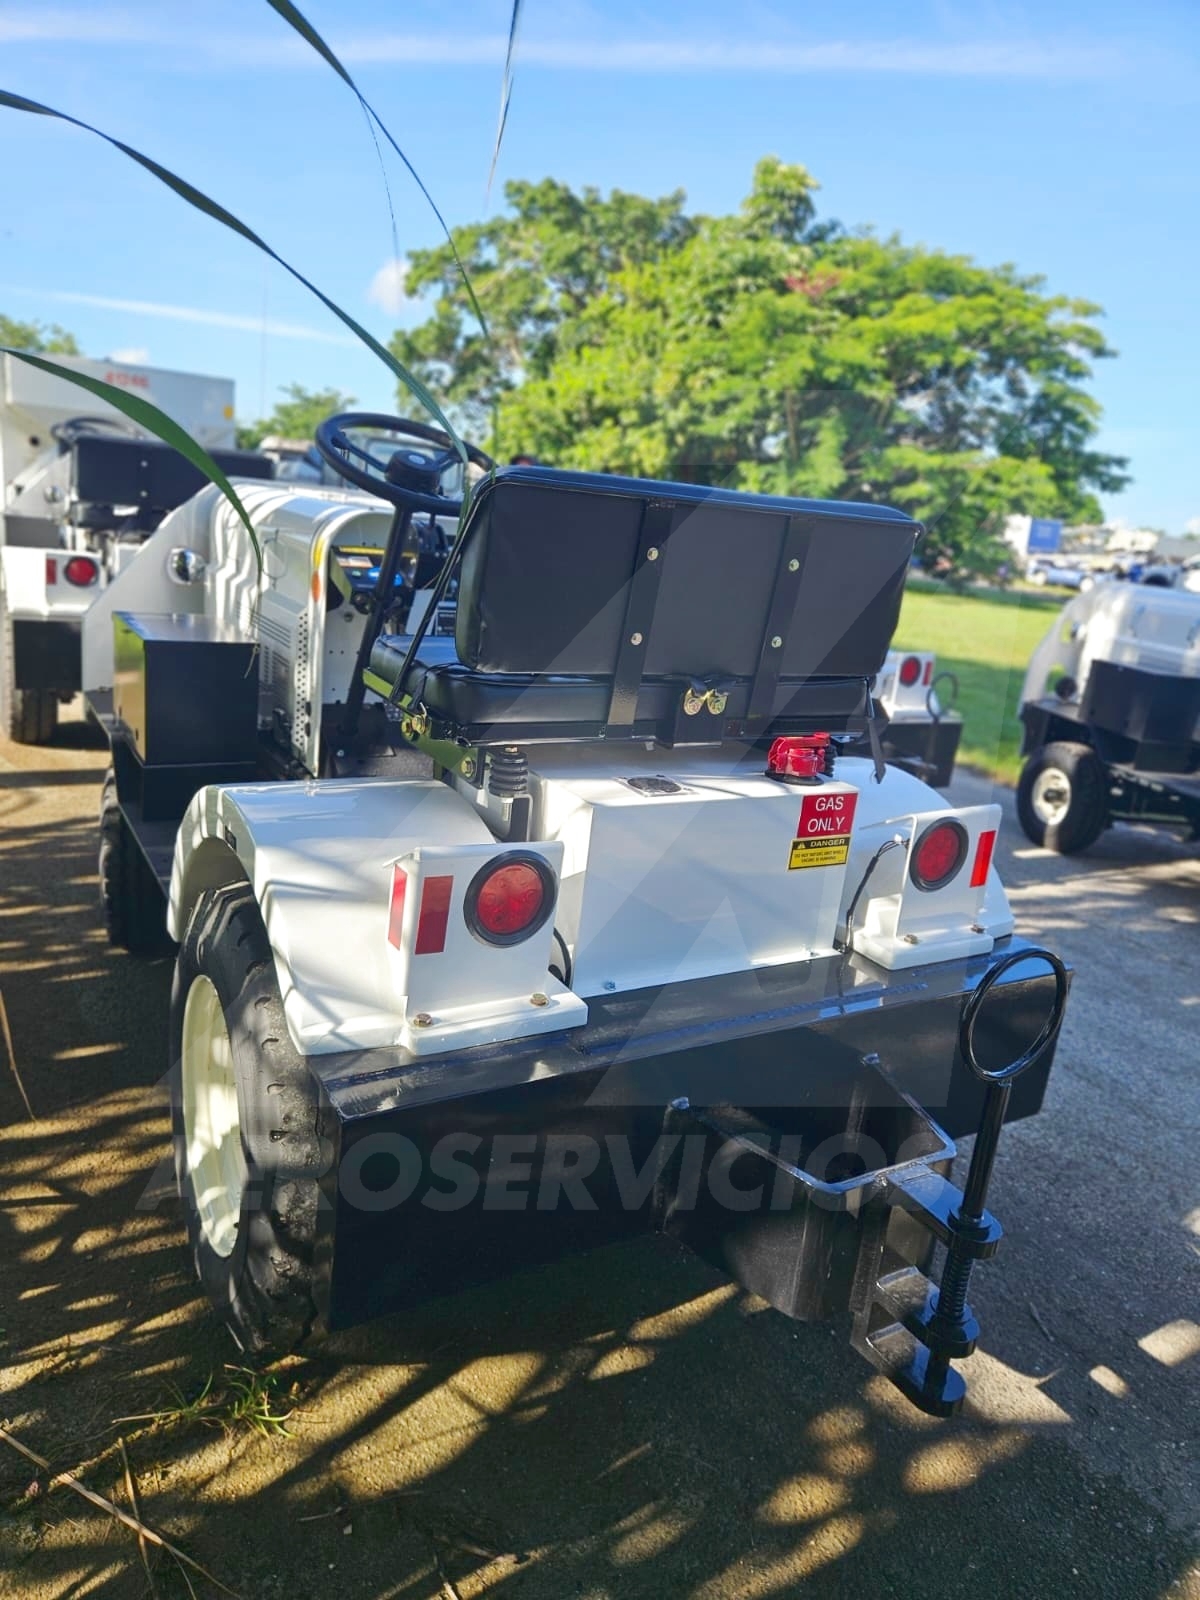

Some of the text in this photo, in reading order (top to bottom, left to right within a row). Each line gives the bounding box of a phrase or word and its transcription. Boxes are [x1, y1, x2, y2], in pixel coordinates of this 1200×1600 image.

[815, 796, 844, 812] GAS
[807, 816, 845, 833] ONLY
[810, 838, 845, 848] DANGER
